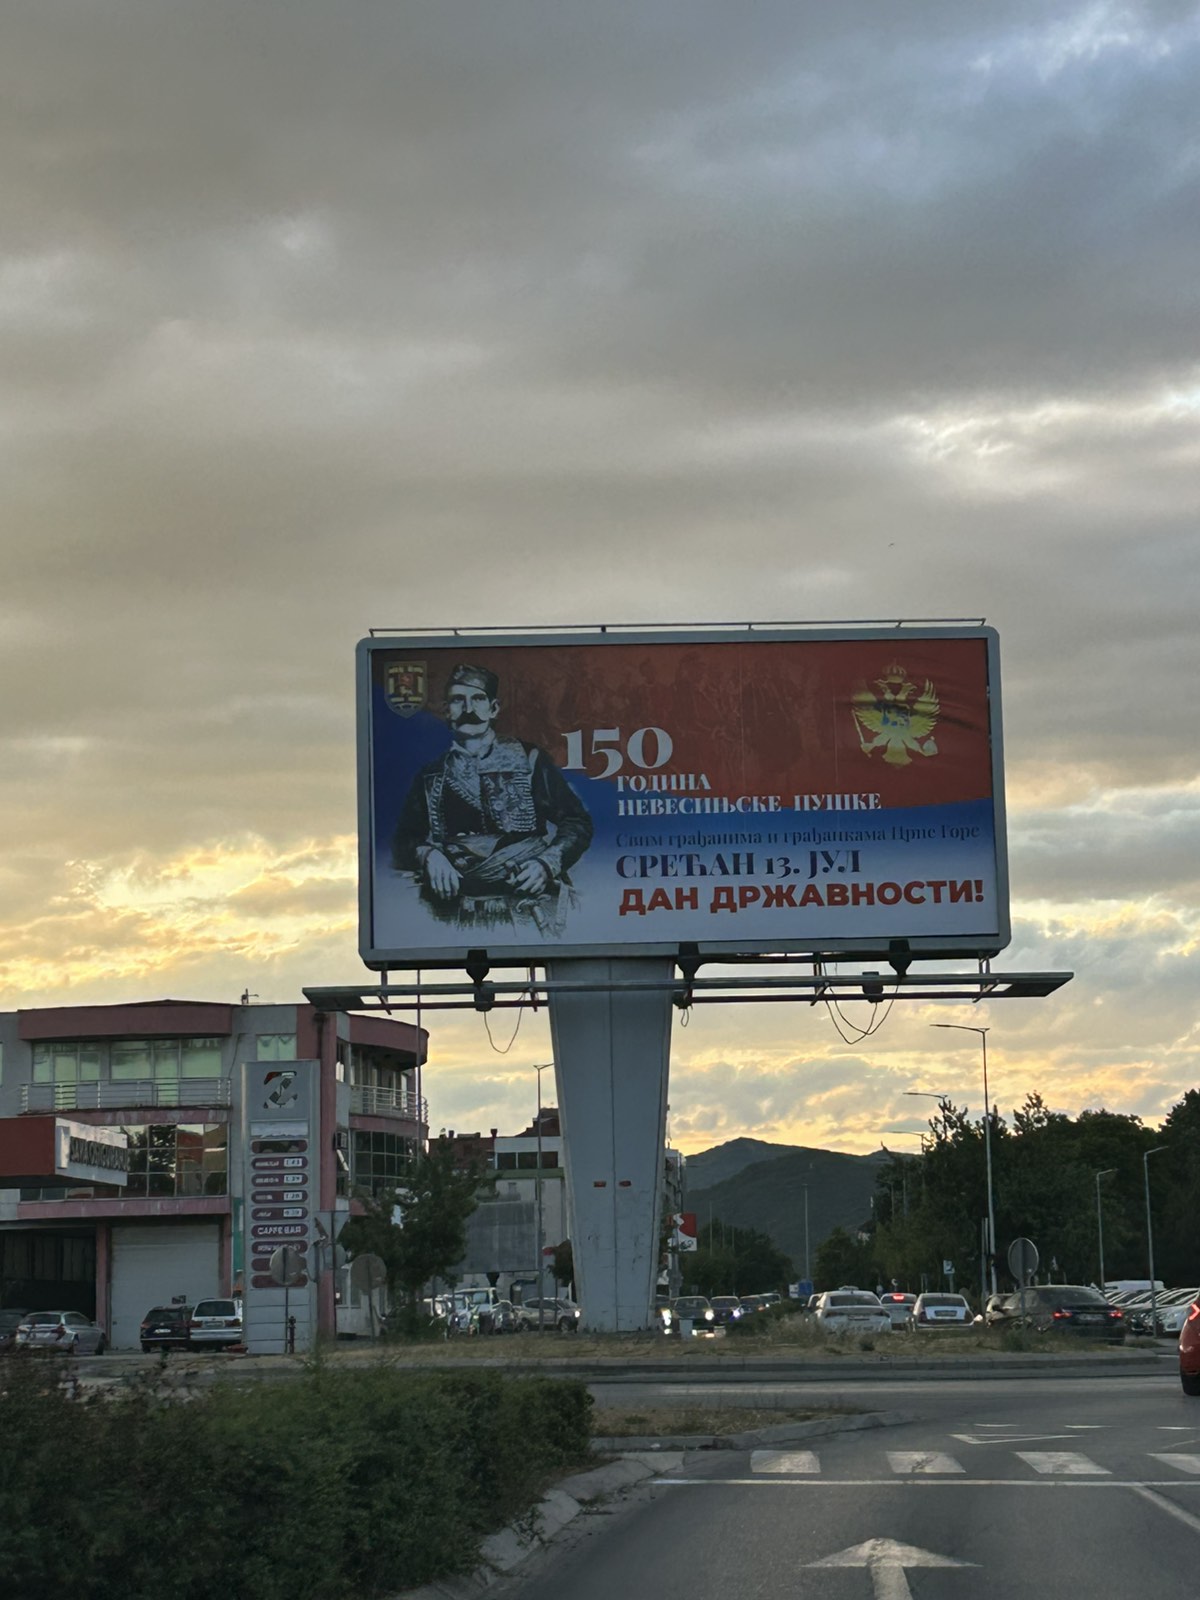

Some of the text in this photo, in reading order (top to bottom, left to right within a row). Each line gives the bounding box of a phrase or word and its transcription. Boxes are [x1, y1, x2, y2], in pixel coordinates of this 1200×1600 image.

[561, 726, 674, 780] 150
[617, 773, 711, 793] ГОДИНА
[618, 792, 882, 816] НЕВЕСИЊСКЕ ПУШКЕ
[616, 824, 981, 849] Свим грађанима и грађанкама Црне Горе
[616, 850, 861, 879] СРЕЋАН 13. ЈУЛ
[619, 879, 984, 916] ДАН ДРЖАВНОСТИ!
